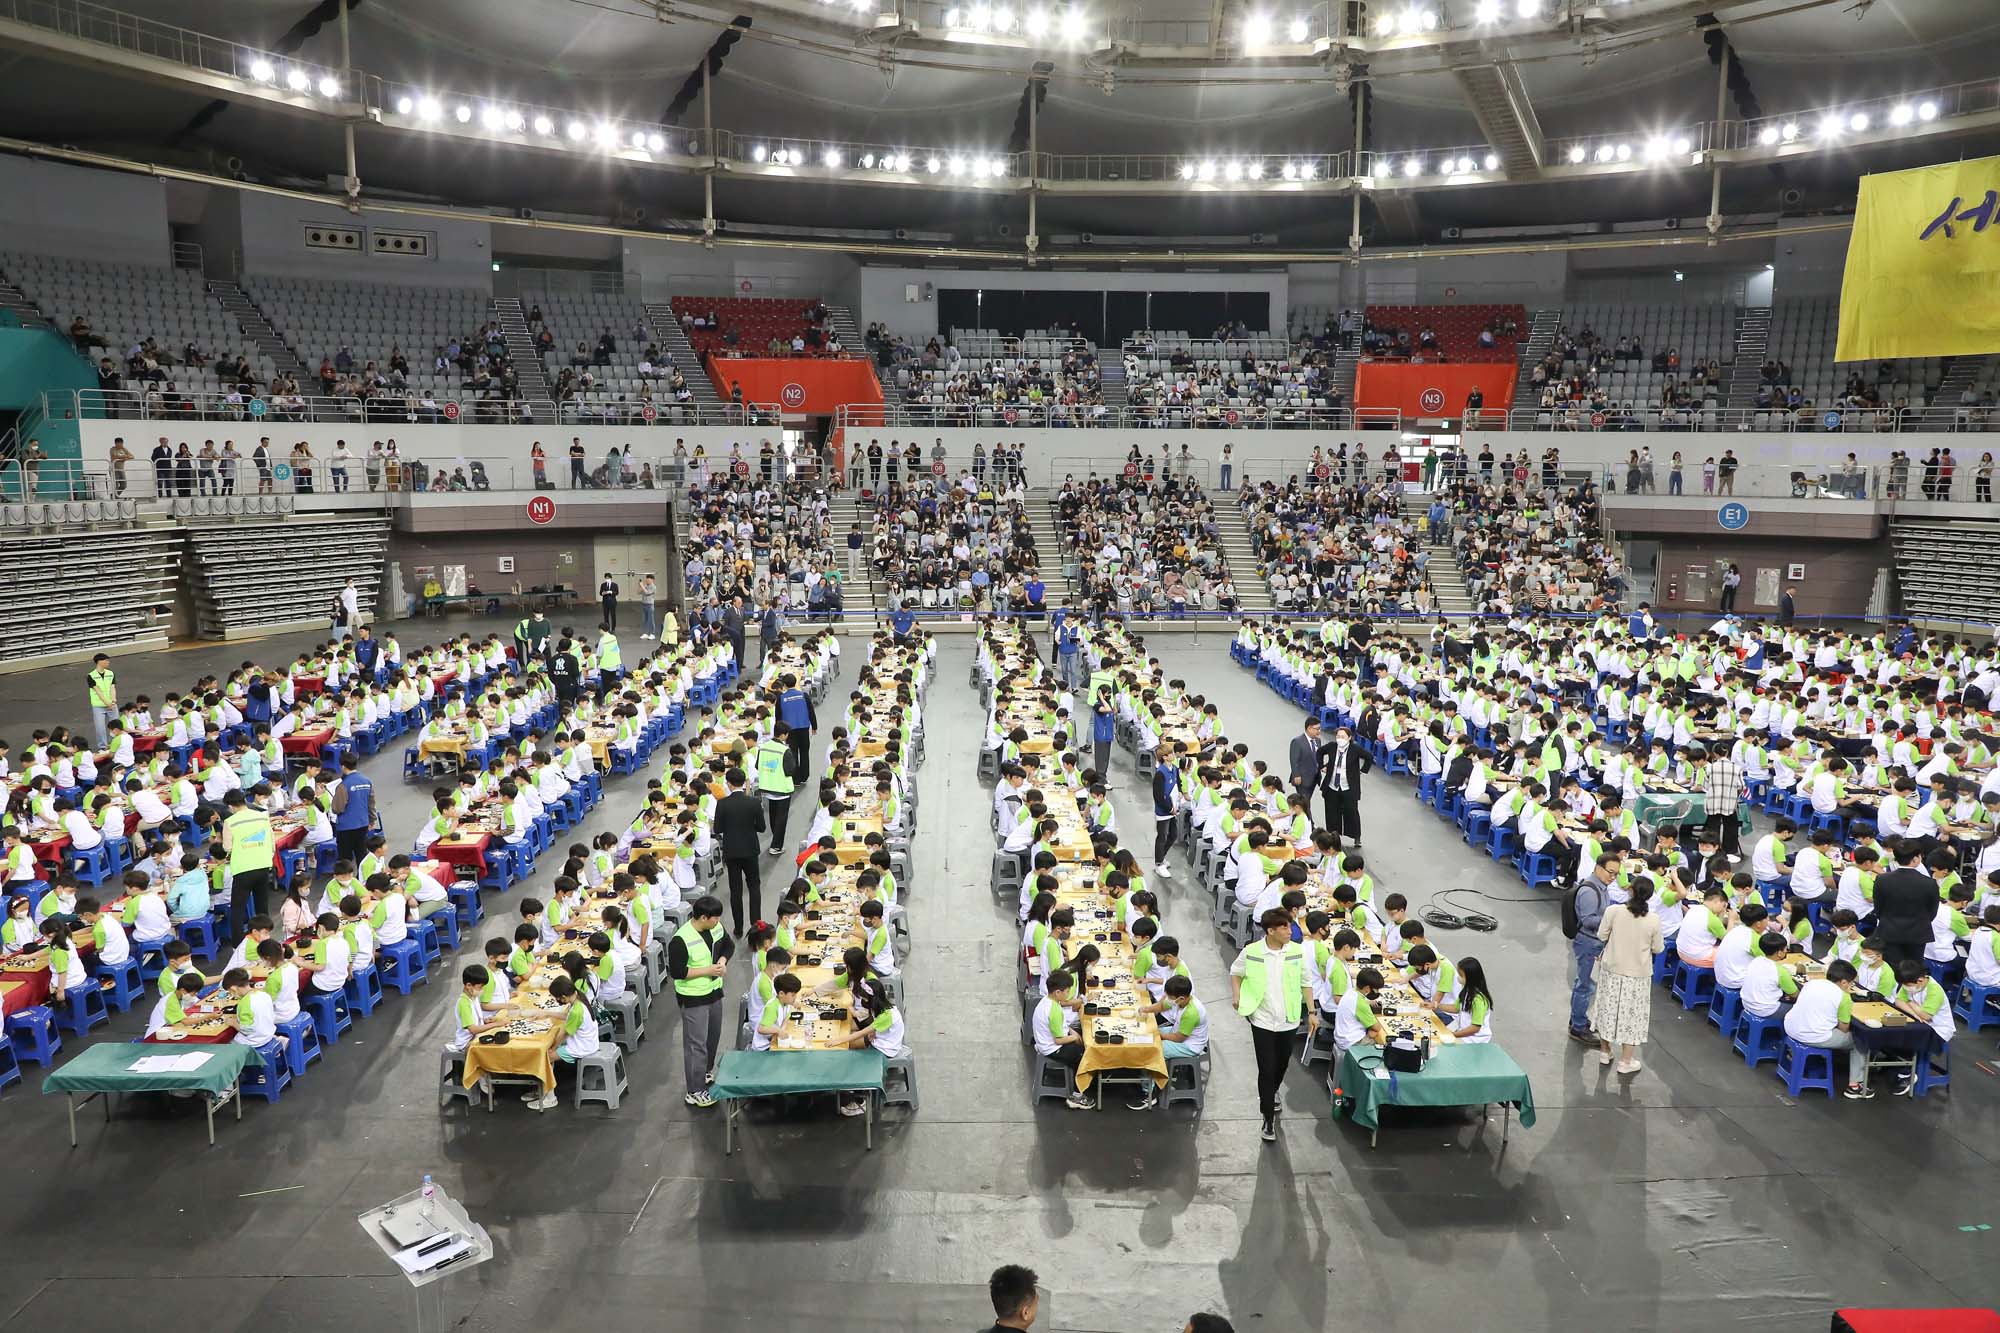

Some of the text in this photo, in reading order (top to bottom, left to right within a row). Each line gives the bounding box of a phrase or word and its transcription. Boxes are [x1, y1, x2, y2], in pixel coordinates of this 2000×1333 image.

[786, 389, 801, 399] N2
[1425, 394, 1440, 404] N3
[533, 502, 549, 513] N1
[1725, 508, 1741, 520] E1
